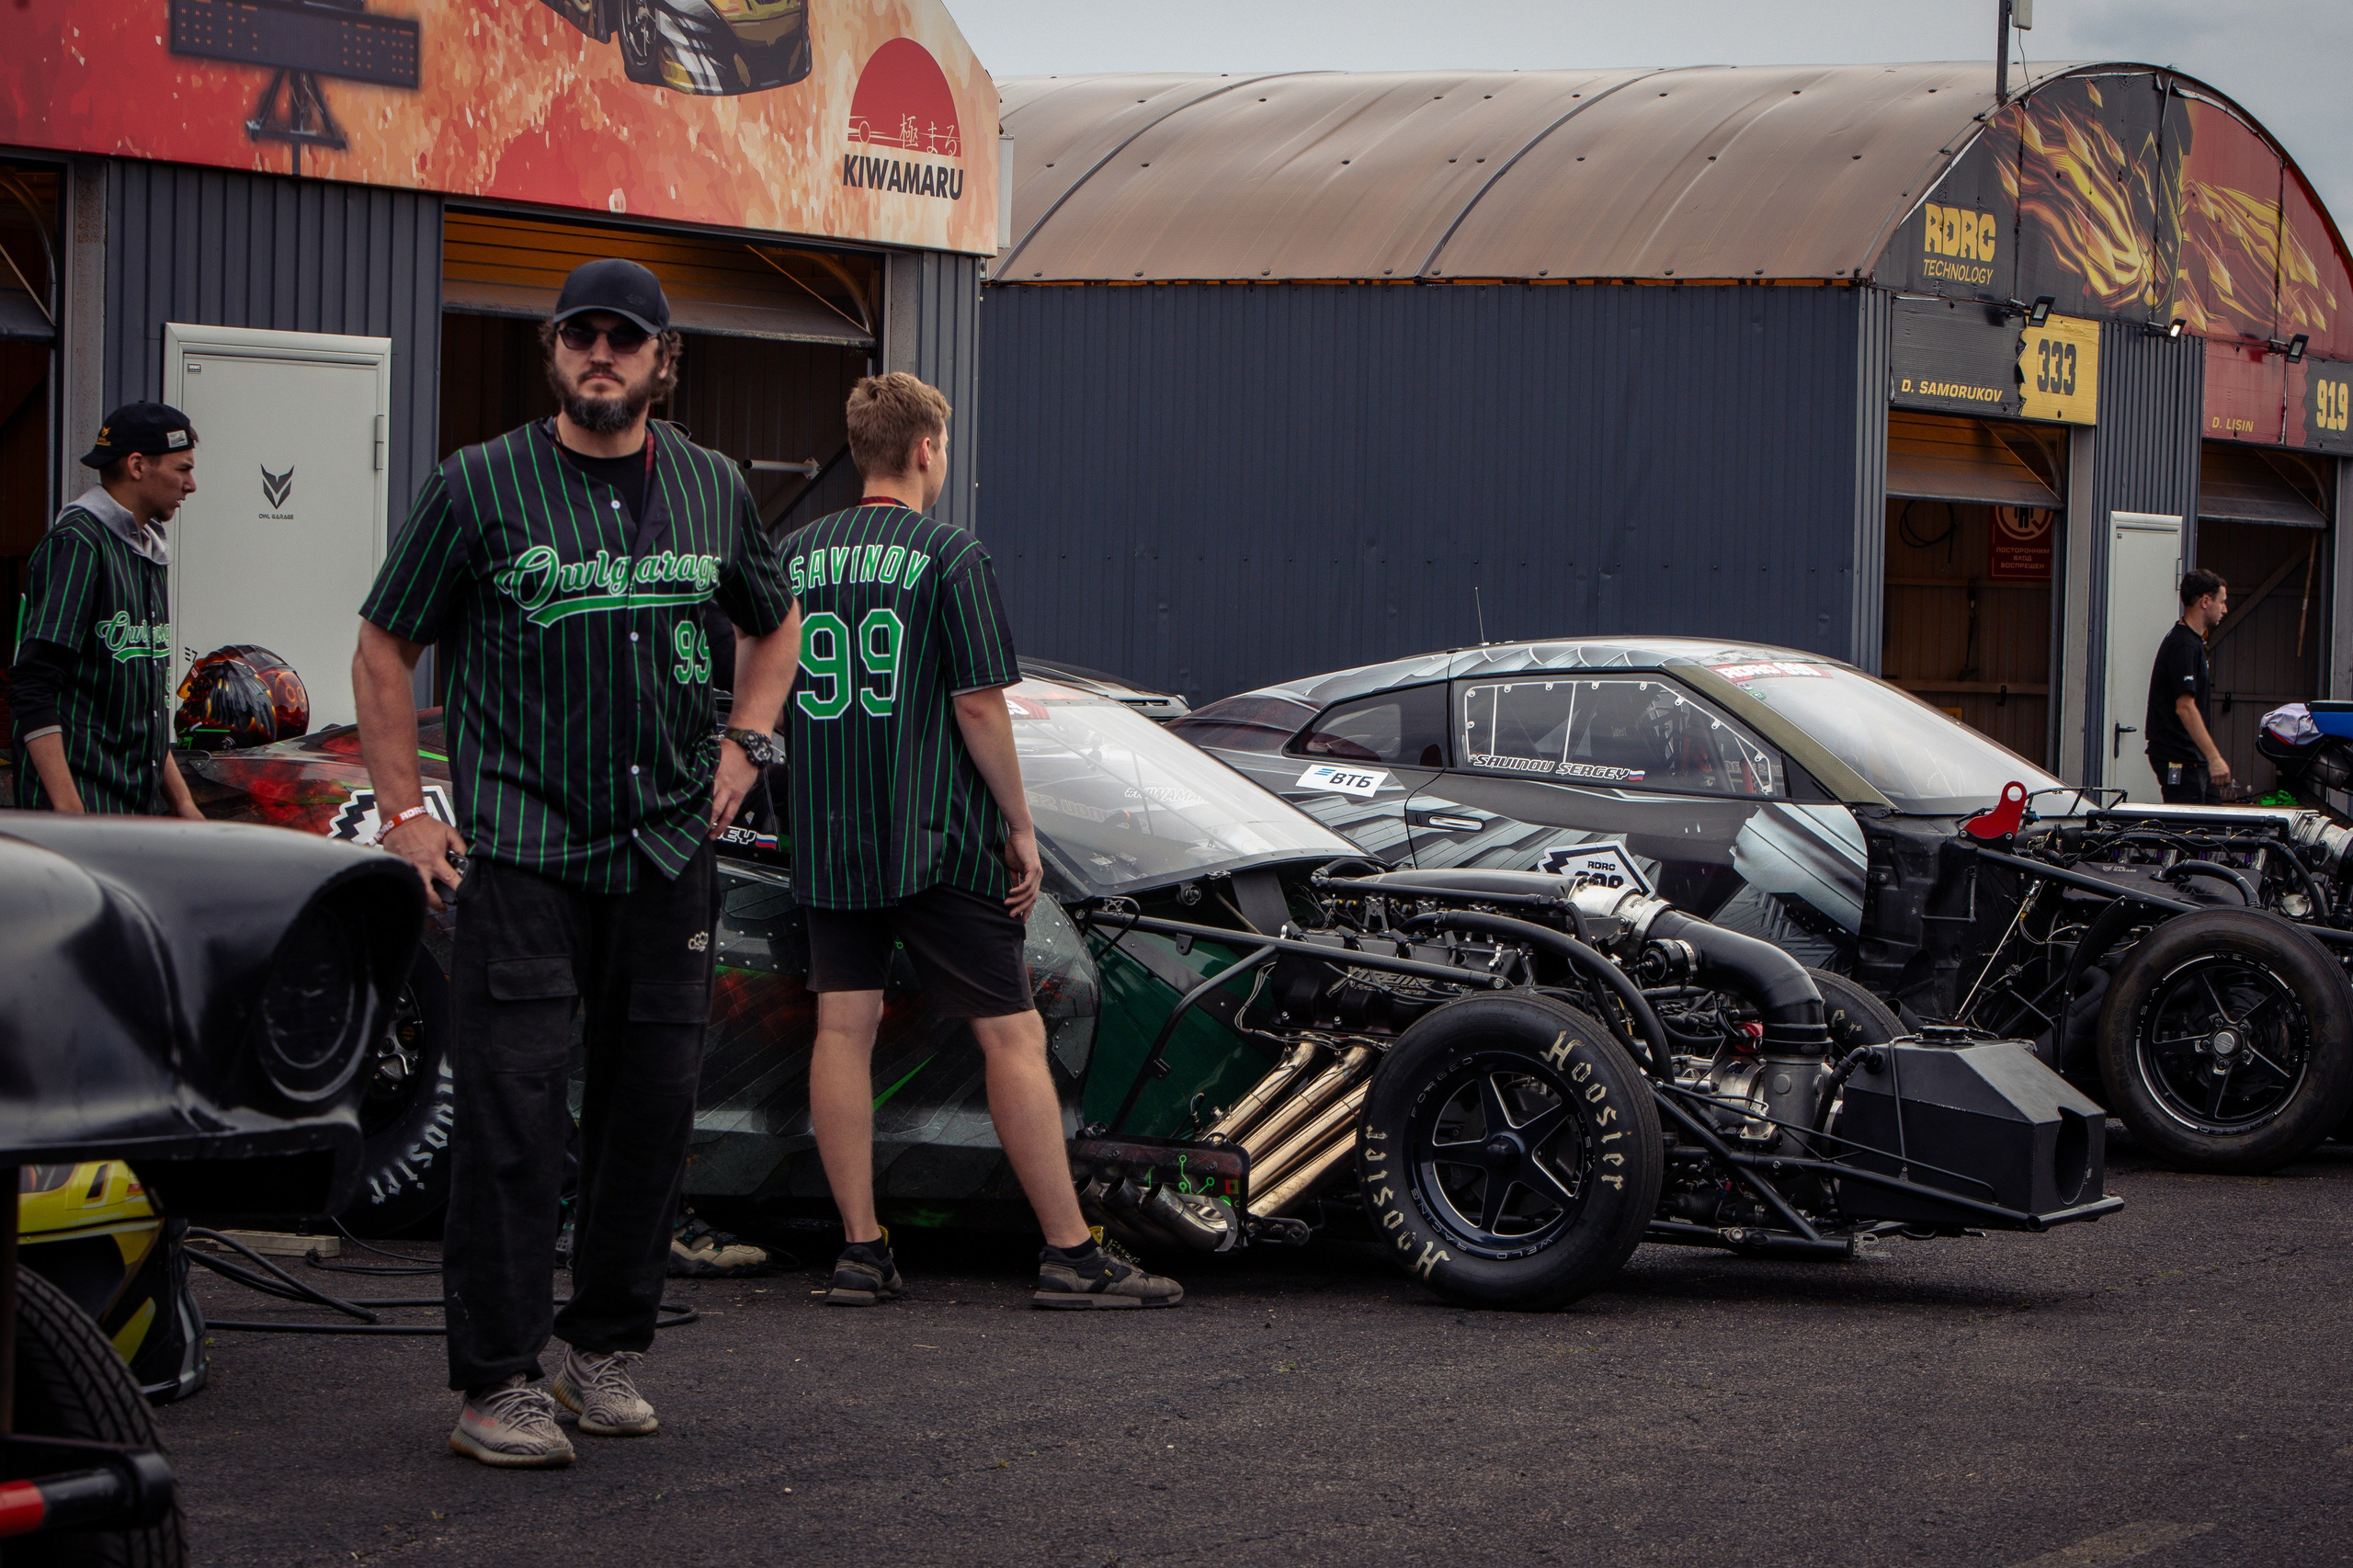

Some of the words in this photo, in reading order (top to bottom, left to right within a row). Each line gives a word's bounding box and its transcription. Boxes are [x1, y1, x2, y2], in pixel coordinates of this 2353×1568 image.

[843, 153, 964, 200] KIWAMARU
[1925, 202, 1996, 263] RDRC
[1924, 258, 1994, 286] TECHNOLOGY
[2037, 338, 2077, 397] 333
[1902, 379, 1915, 393] D.
[1919, 381, 2003, 403] SAMORUKOV
[2316, 379, 2349, 432] 919
[2211, 416, 2222, 429] D.
[2225, 418, 2255, 433] LISIN
[1995, 546, 2051, 554] ПОСТОРОННИМ
[2000, 562, 2045, 570] ВОСПРЕЩЕН
[2013, 554, 2032, 562] ВХОД
[789, 544, 931, 597] SAVINOV
[796, 608, 904, 721] 99
[1715, 664, 1782, 679] RDRC
[1328, 772, 1375, 789] ВТБ
[1555, 762, 1631, 781] SERGEY
[1587, 860, 1617, 871] RDRC
[2214, 951, 2270, 972] WELD
[2286, 987, 2311, 1062] RACING
[1410, 1056, 1473, 1119] FORGED
[1540, 1030, 1632, 1191] Hoosier
[1361, 1124, 1451, 1279] Hoosier
[1410, 1187, 1468, 1252] RACING
[1496, 1237, 1554, 1260] WELD
